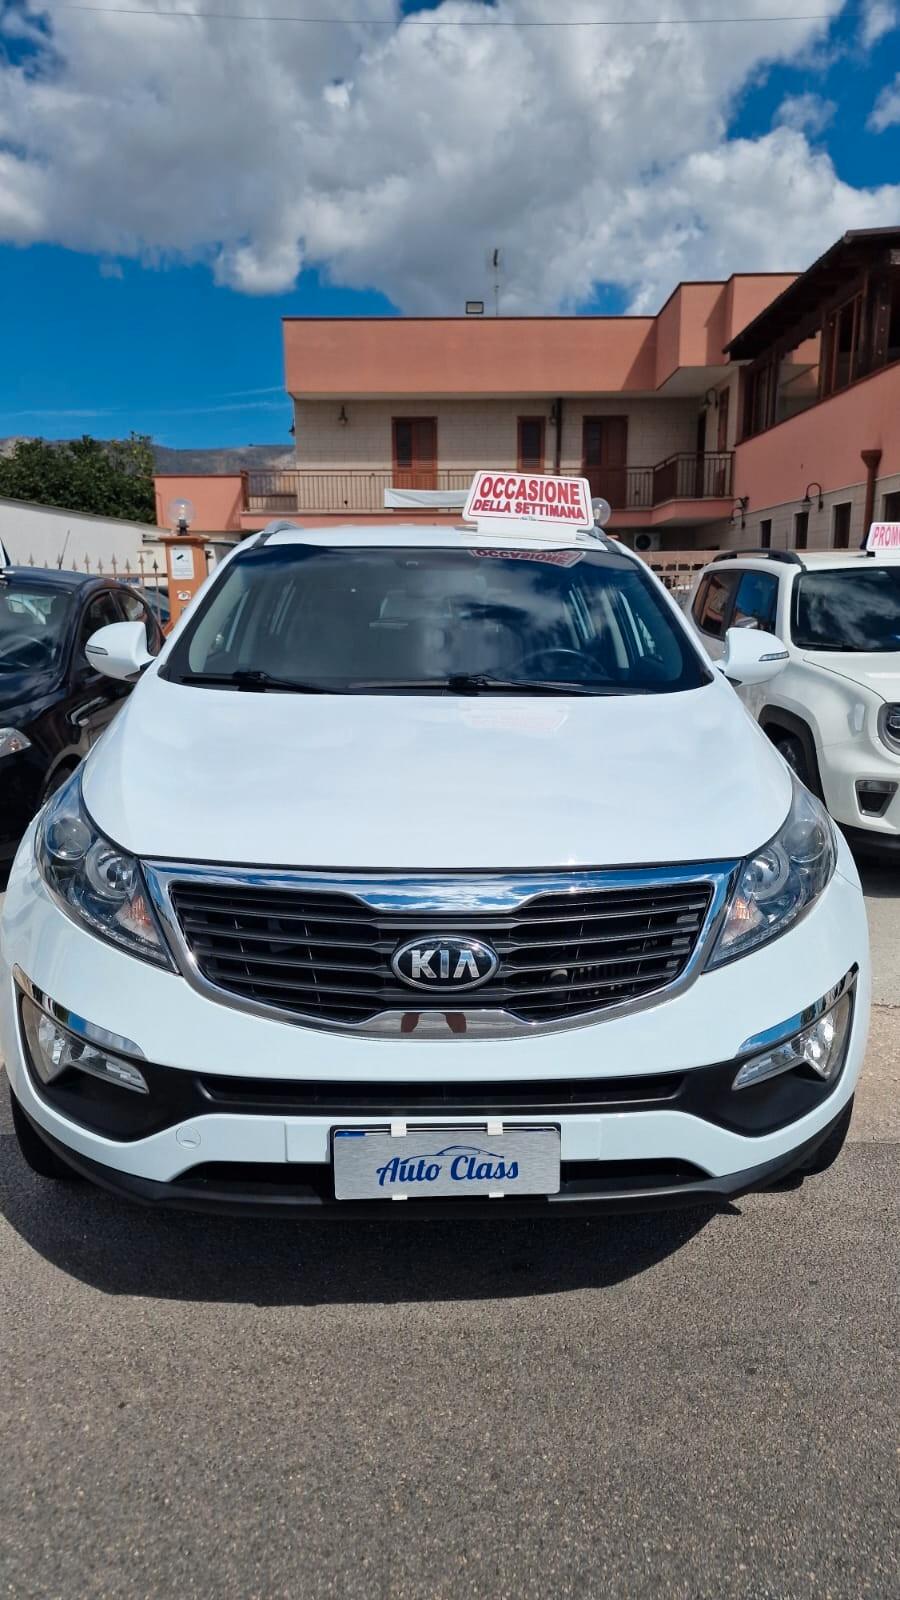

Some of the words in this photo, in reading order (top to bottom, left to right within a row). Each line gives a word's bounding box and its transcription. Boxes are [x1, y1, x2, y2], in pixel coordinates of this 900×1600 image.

[480, 477, 580, 505] OCCASIONE
[473, 499, 511, 513] DELLA
[515, 502, 584, 519] SETTIMANA
[872, 526, 900, 546] PROM
[410, 949, 480, 979] KIA
[376, 1157, 442, 1186] Auto
[450, 1155, 519, 1181] Class
